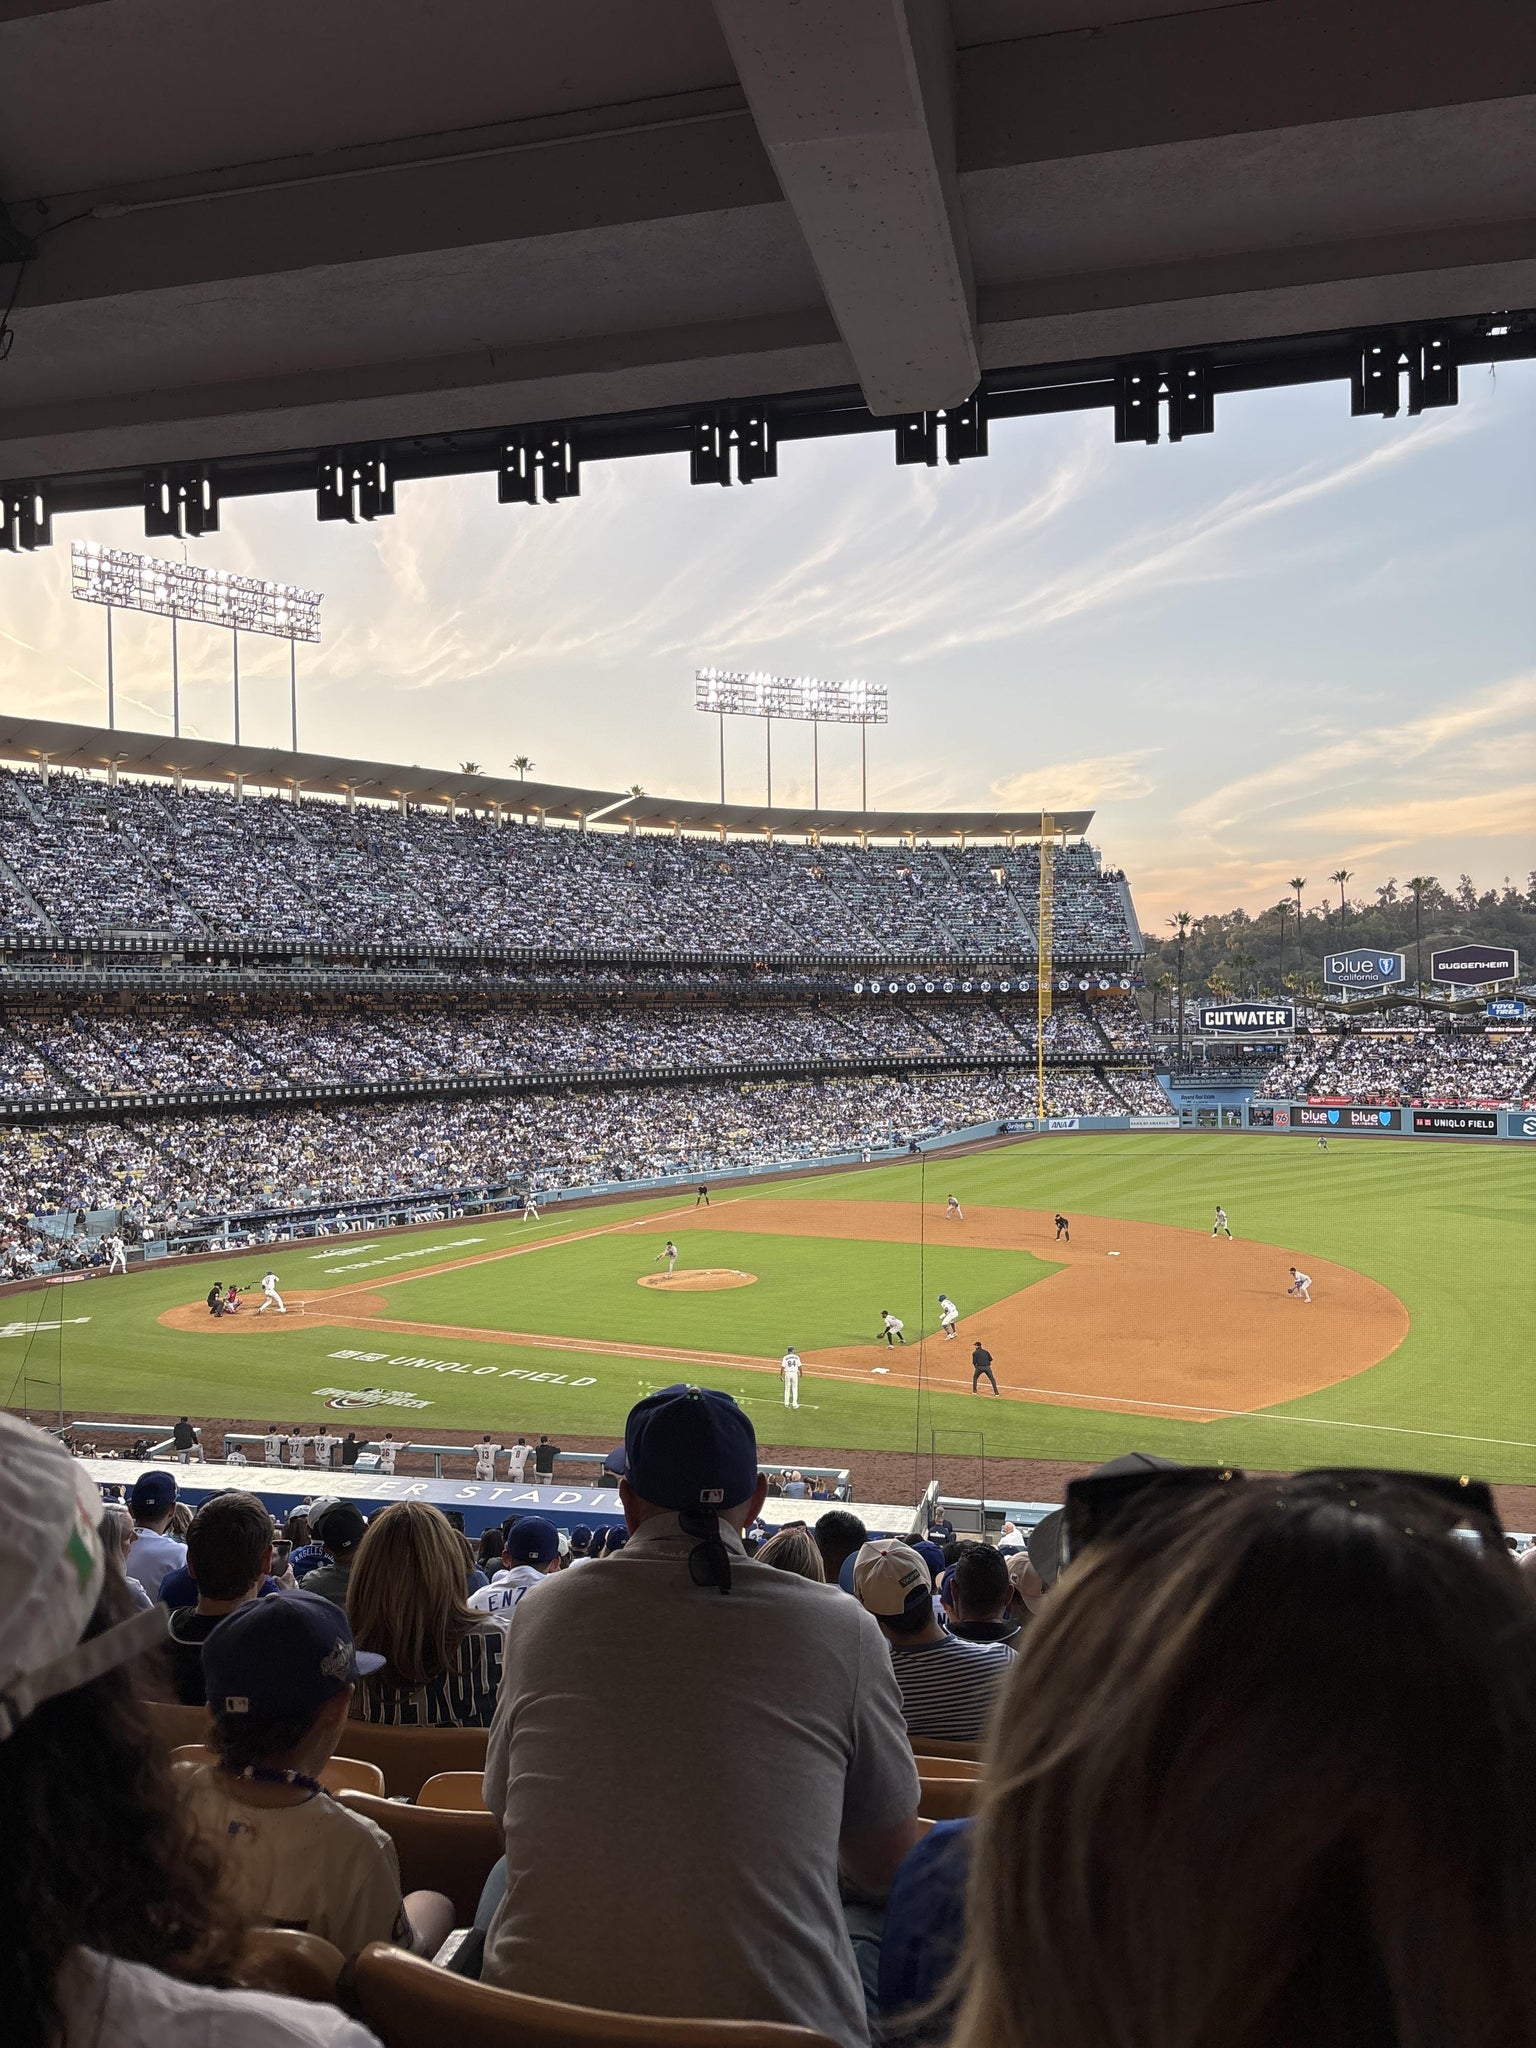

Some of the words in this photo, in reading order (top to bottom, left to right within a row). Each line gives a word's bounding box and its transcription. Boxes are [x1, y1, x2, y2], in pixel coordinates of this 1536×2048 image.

[1331, 957, 1374, 974] blue
[1438, 961, 1509, 970] GUGGENHEIM
[1338, 973, 1379, 982] california
[1205, 1011, 1286, 1026] CUTWATER
[1275, 1112, 1289, 1124] 76
[1301, 1109, 1328, 1121] blue
[1351, 1111, 1379, 1123] blue
[1051, 1121, 1067, 1129] ANA
[1433, 1118, 1466, 1128] UNIQLO
[1468, 1119, 1495, 1129] FIELD
[787, 1360, 796, 1368] 84
[387, 1356, 499, 1375] UNIQLO
[498, 1369, 598, 1387] FIELD
[265, 1440, 274, 1450] 71
[289, 1444, 299, 1453] 77
[316, 1442, 325, 1451] 72
[381, 1448, 390, 1457] 36
[481, 1450, 490, 1460] 13
[454, 1485, 624, 1508] STADI
[294, 1546, 325, 1562] ANGELES
